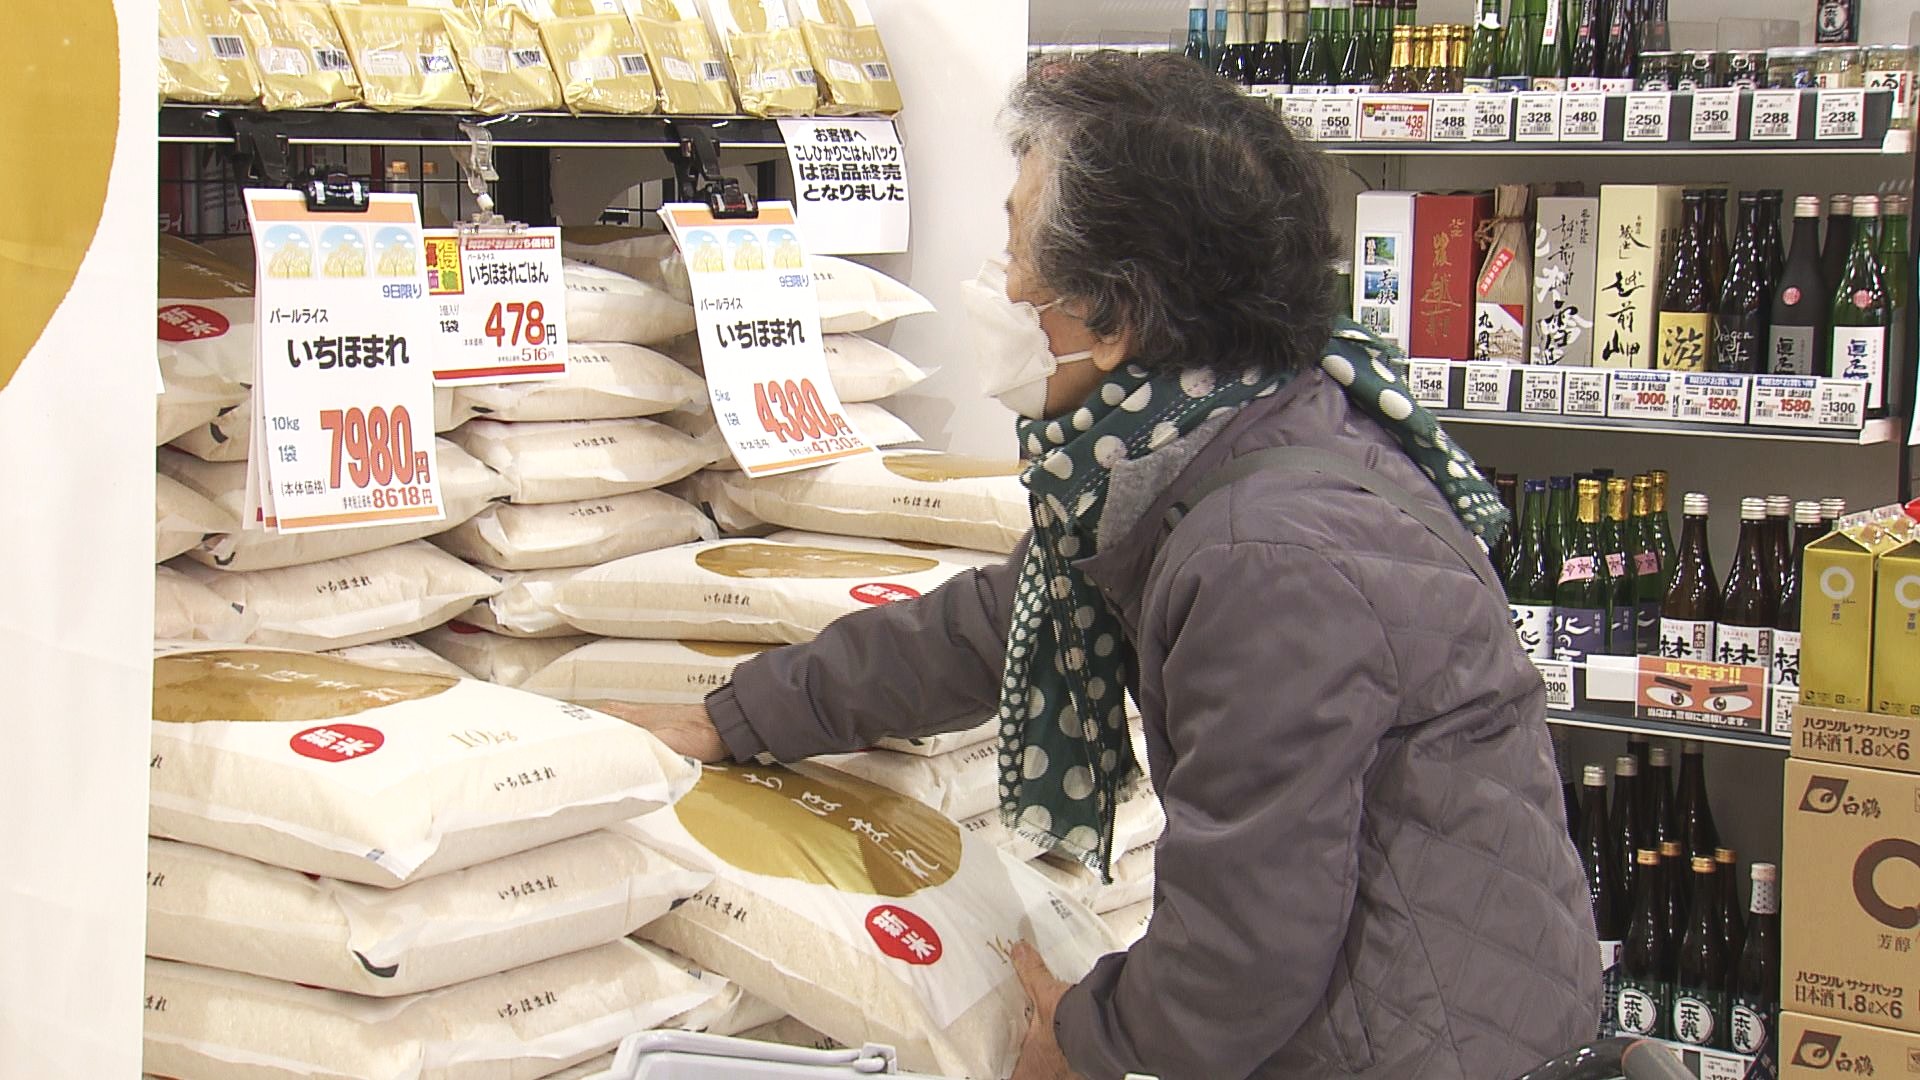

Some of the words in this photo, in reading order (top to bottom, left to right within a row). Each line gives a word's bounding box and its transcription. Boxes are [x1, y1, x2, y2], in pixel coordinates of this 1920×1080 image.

[1327, 116, 1349, 127] 650
[1405, 115, 1424, 129] 438
[1442, 116, 1465, 127] 488
[1481, 114, 1504, 124] 400
[1527, 112, 1551, 123] 328
[1573, 111, 1597, 122] 480
[1635, 114, 1661, 126] 250
[1702, 110, 1729, 121] 350
[1762, 112, 1789, 124] 288
[1828, 112, 1856, 123] 238
[813, 127, 867, 142] お客様へ
[794, 144, 897, 162] こしひかりごはんパック
[799, 163, 902, 181] は商品終売
[803, 184, 904, 201] となりました
[469, 262, 549, 285] いちほまれごはん
[779, 275, 809, 288] 9日限り
[382, 284, 422, 299] 9日限り
[440, 319, 459, 333] 1袋
[716, 318, 805, 349] いちほまれ
[287, 334, 410, 370] いちほまれ
[1420, 379, 1442, 390] 1548
[1475, 382, 1498, 392] 1200
[1533, 388, 1556, 399] 1750
[1575, 390, 1599, 401] 1250
[1636, 392, 1666, 405] 1000
[1707, 396, 1738, 411] 1500
[1780, 398, 1812, 412] 1580
[1829, 401, 1856, 413] 1300
[272, 416, 300, 431] 10kg
[278, 444, 298, 463] 1袋
[892, 495, 942, 508] いちほまれ
[316, 576, 373, 593] いちほまれ
[703, 592, 751, 606] いちほまれ
[1803, 717, 1850, 732] ハクツル
[1854, 723, 1910, 740] サケパック
[300, 728, 375, 757] 新米
[448, 729, 519, 748] 10kg
[1802, 731, 1841, 752] 日本酒
[494, 766, 556, 791] いちほまれ
[497, 875, 558, 900] いちほまれ
[871, 907, 937, 961] 新米
[1796, 970, 1843, 988] ハクツル
[1846, 978, 1903, 998] サケパック
[1795, 984, 1834, 1008] 日本酒
[497, 990, 558, 1020] いちほまれ
